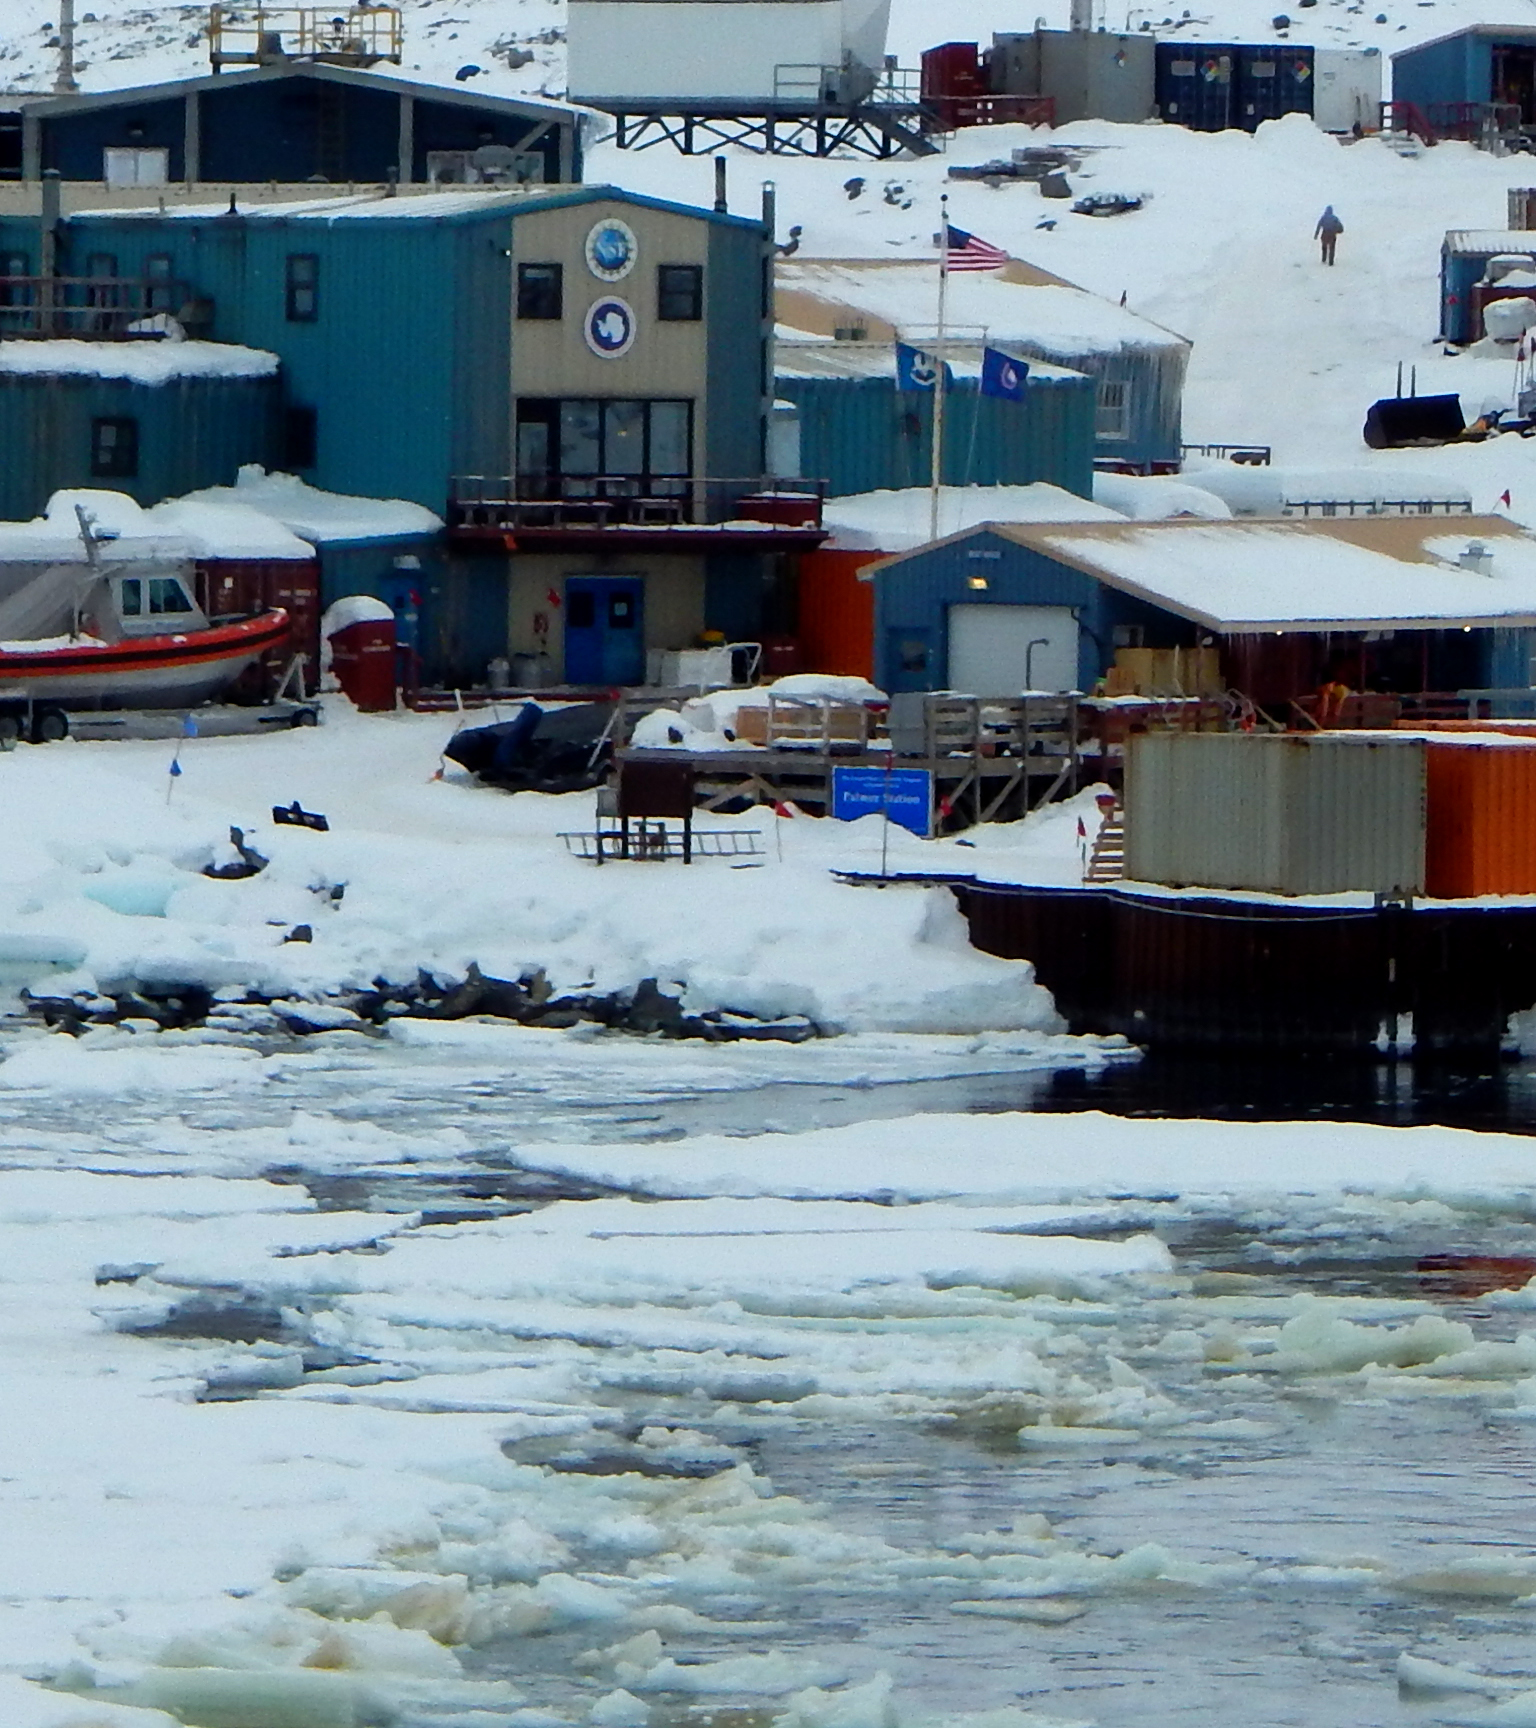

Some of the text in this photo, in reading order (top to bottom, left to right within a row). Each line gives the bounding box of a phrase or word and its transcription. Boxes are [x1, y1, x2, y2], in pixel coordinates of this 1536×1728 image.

[596, 242, 627, 259] NSF
[843, 791, 920, 804] Palmer Station
